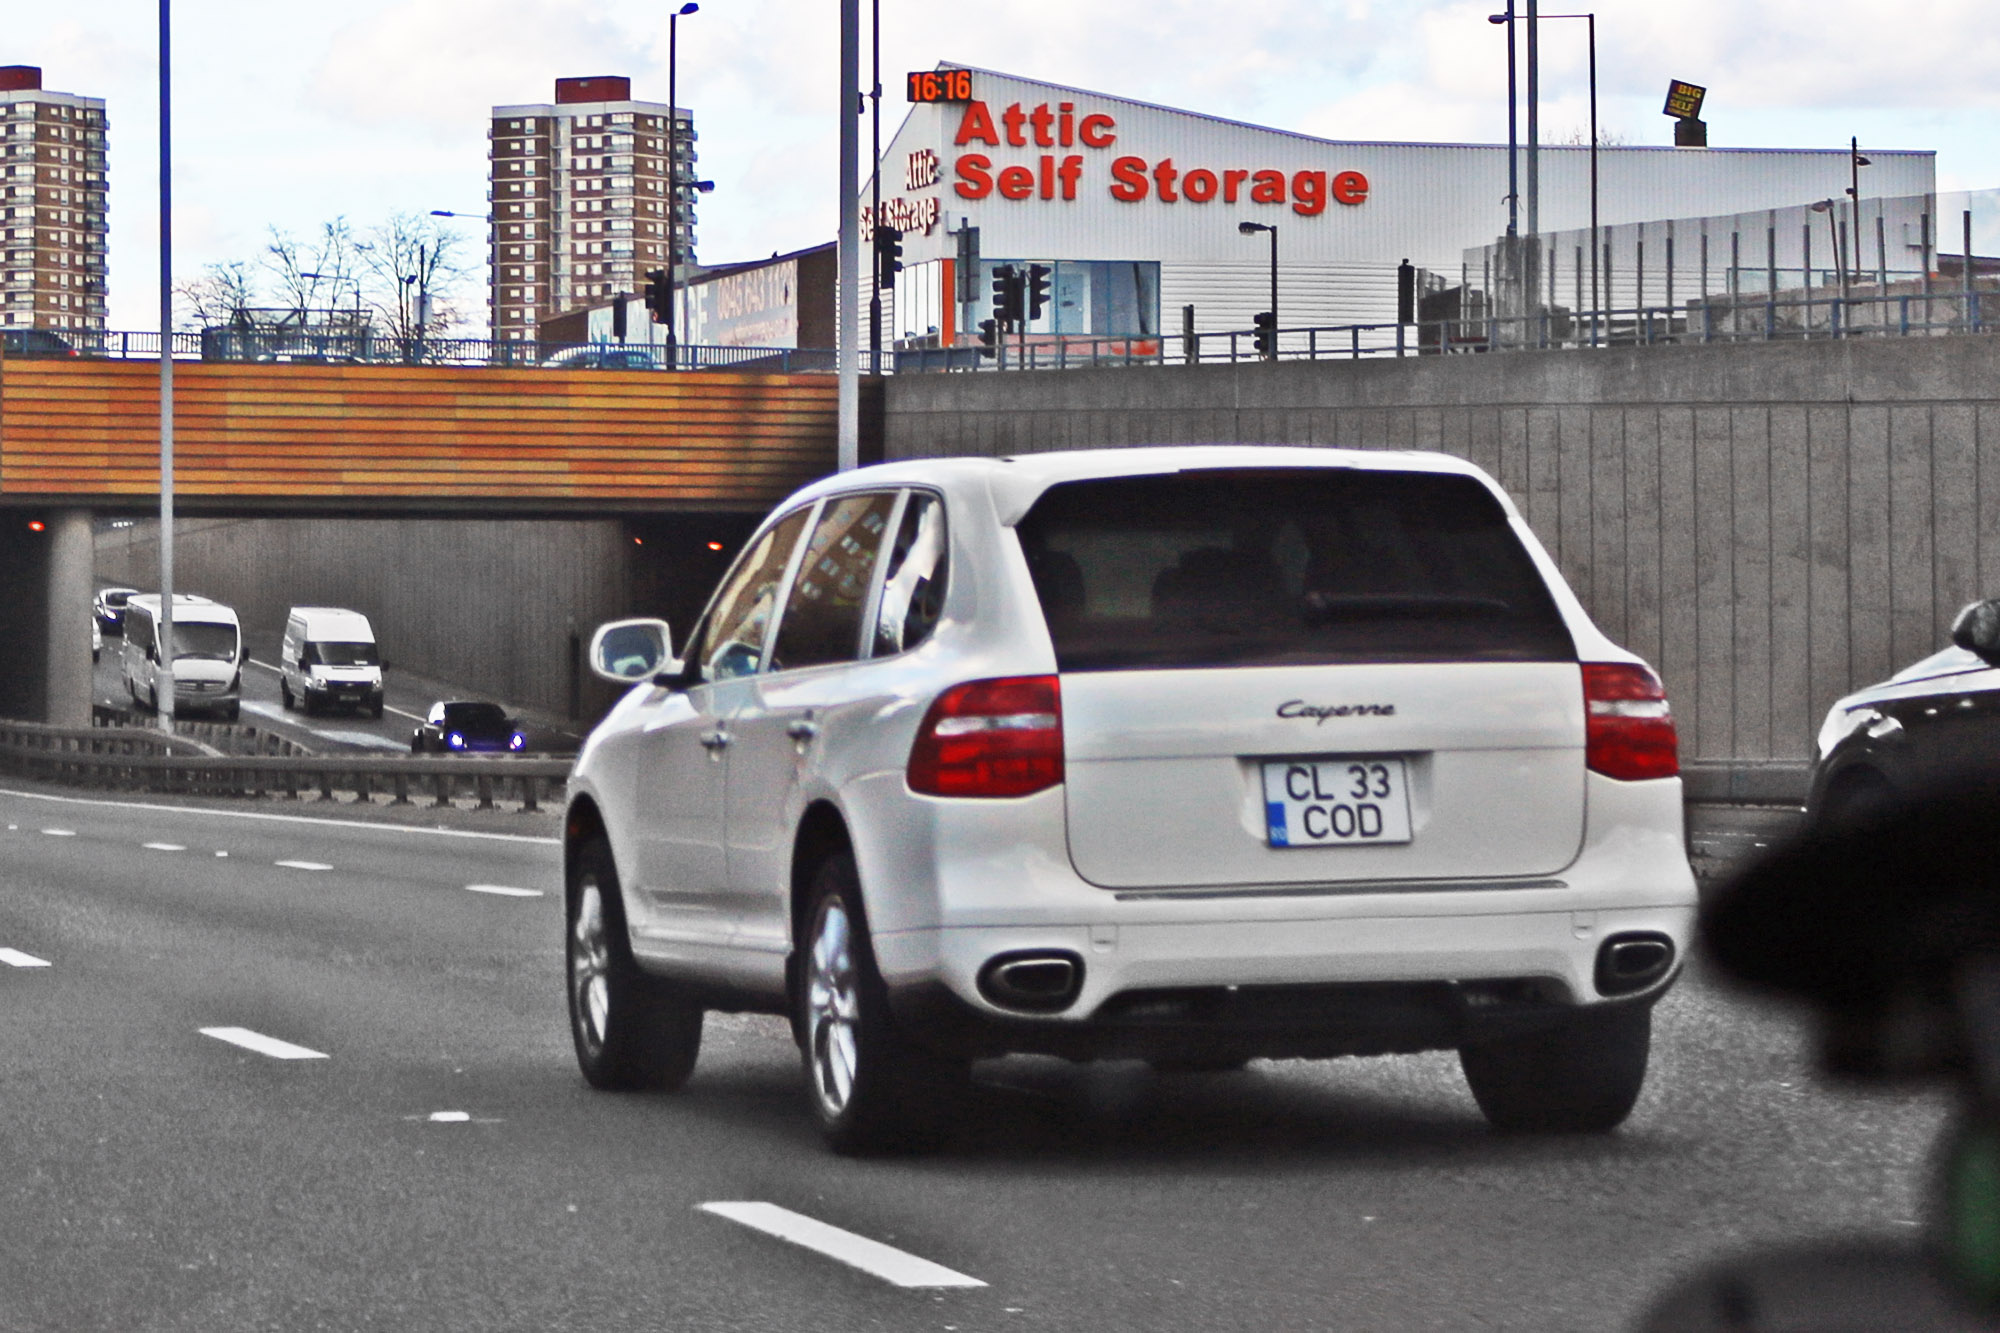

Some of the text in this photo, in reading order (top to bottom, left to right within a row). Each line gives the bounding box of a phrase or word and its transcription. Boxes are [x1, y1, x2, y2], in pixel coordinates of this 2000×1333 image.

[911, 71, 970, 100] 16:16
[1679, 84, 1702, 98] BIG
[954, 101, 1116, 147] Attic
[906, 149, 938, 190] Attic
[954, 154, 1368, 216] Self Storage
[859, 197, 938, 241] Sef Storage
[1277, 699, 1395, 726] Cayenne
[1286, 765, 1390, 801] CL 33
[1304, 804, 1382, 839] COD
